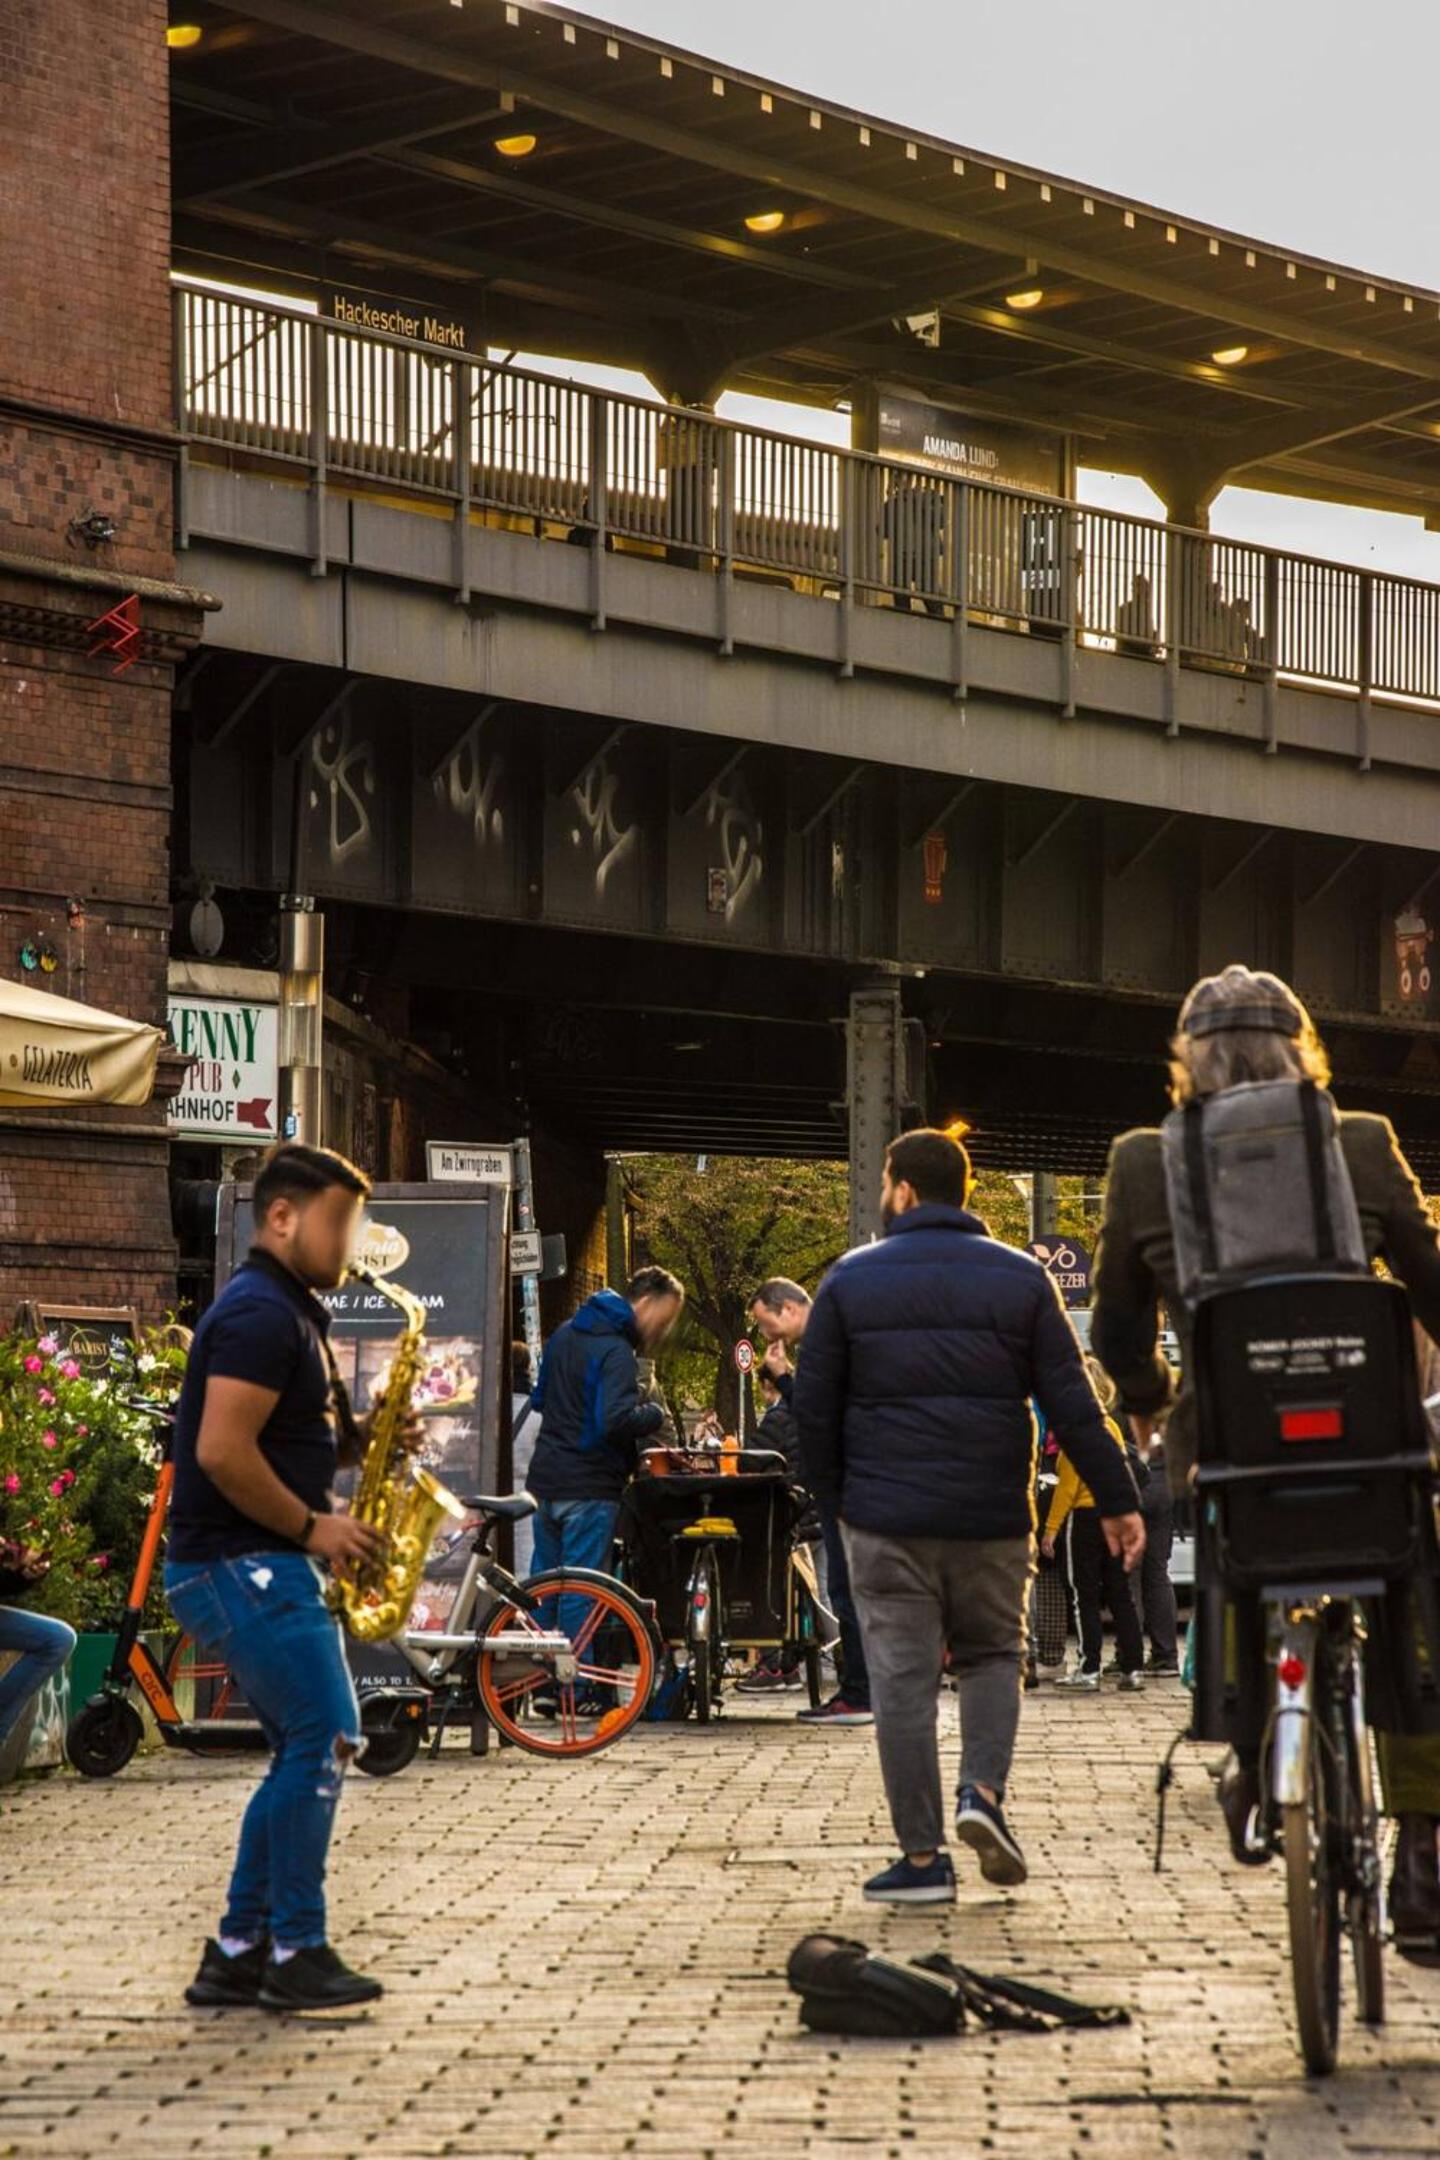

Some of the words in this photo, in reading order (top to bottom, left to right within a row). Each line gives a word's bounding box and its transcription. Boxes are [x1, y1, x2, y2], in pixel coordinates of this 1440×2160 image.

[334, 295, 420, 337] Hackescher
[424, 316, 465, 348] Markt
[923, 434, 967, 463] AMANDA
[23, 1044, 93, 1091] GELATERIA
[189, 1061, 223, 1093] PUB
[441, 1152, 454, 1172] Am
[454, 1152, 502, 1178] Zwirngraben
[363, 1295, 387, 1309] ICE
[739, 1348, 750, 1363] 30
[360, 1673, 386, 1686] ALSO
[390, 1673, 402, 1686] TO
